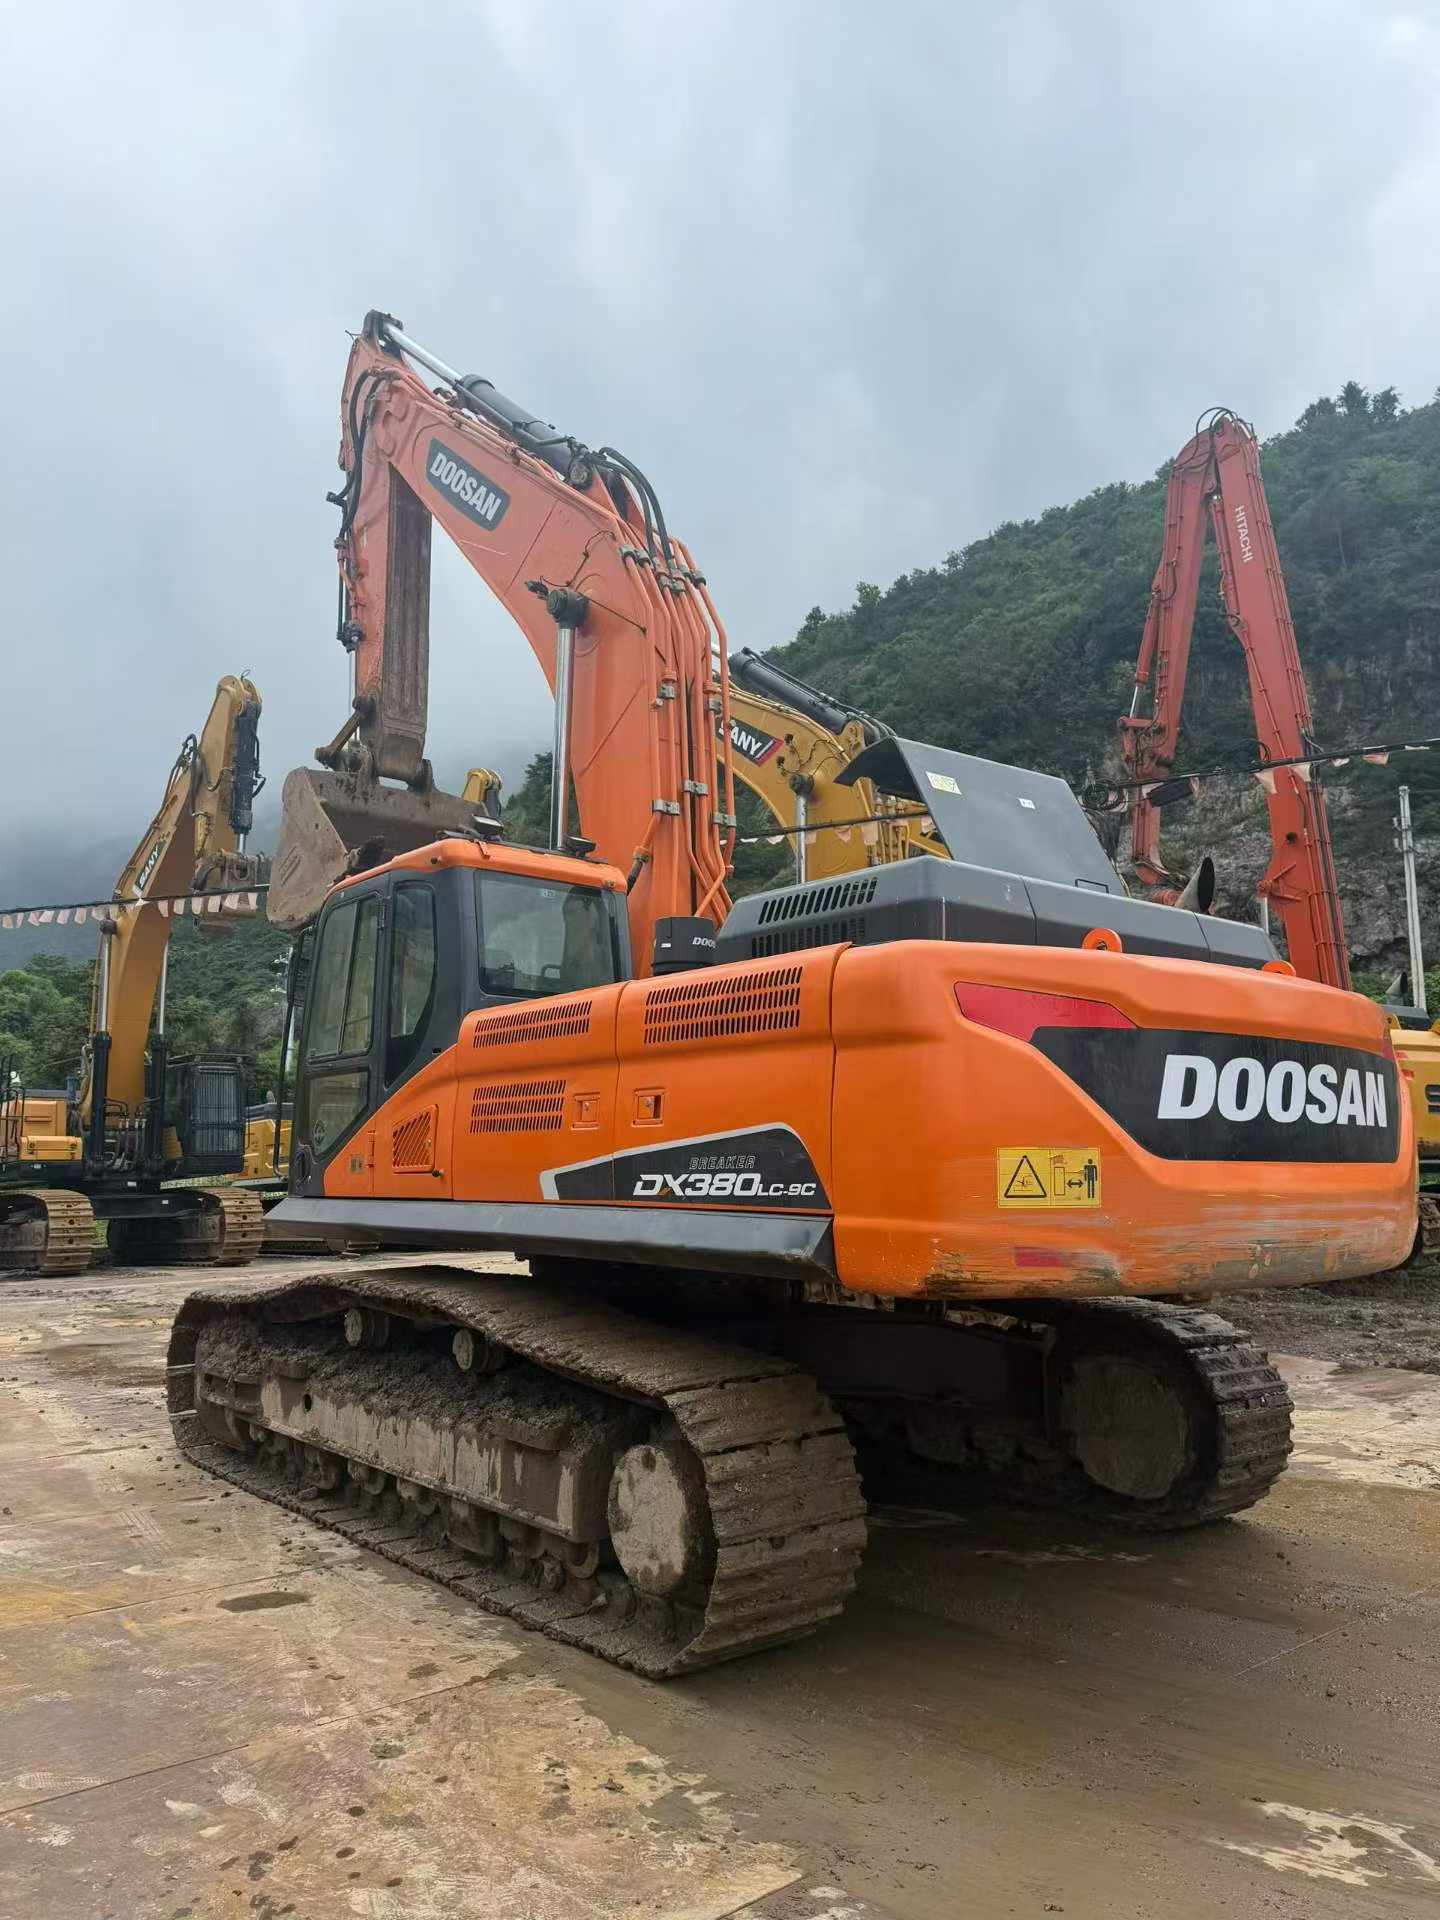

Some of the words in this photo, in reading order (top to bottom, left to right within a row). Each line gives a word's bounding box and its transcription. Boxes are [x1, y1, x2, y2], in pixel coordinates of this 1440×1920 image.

[430, 452, 502, 521] DOOSAN
[1235, 505, 1254, 562] HITACHI
[1157, 1054, 1388, 1128] DOOSAN
[633, 1173, 816, 1197] DX380LC-9C
[689, 1155, 756, 1170] BREAKER
